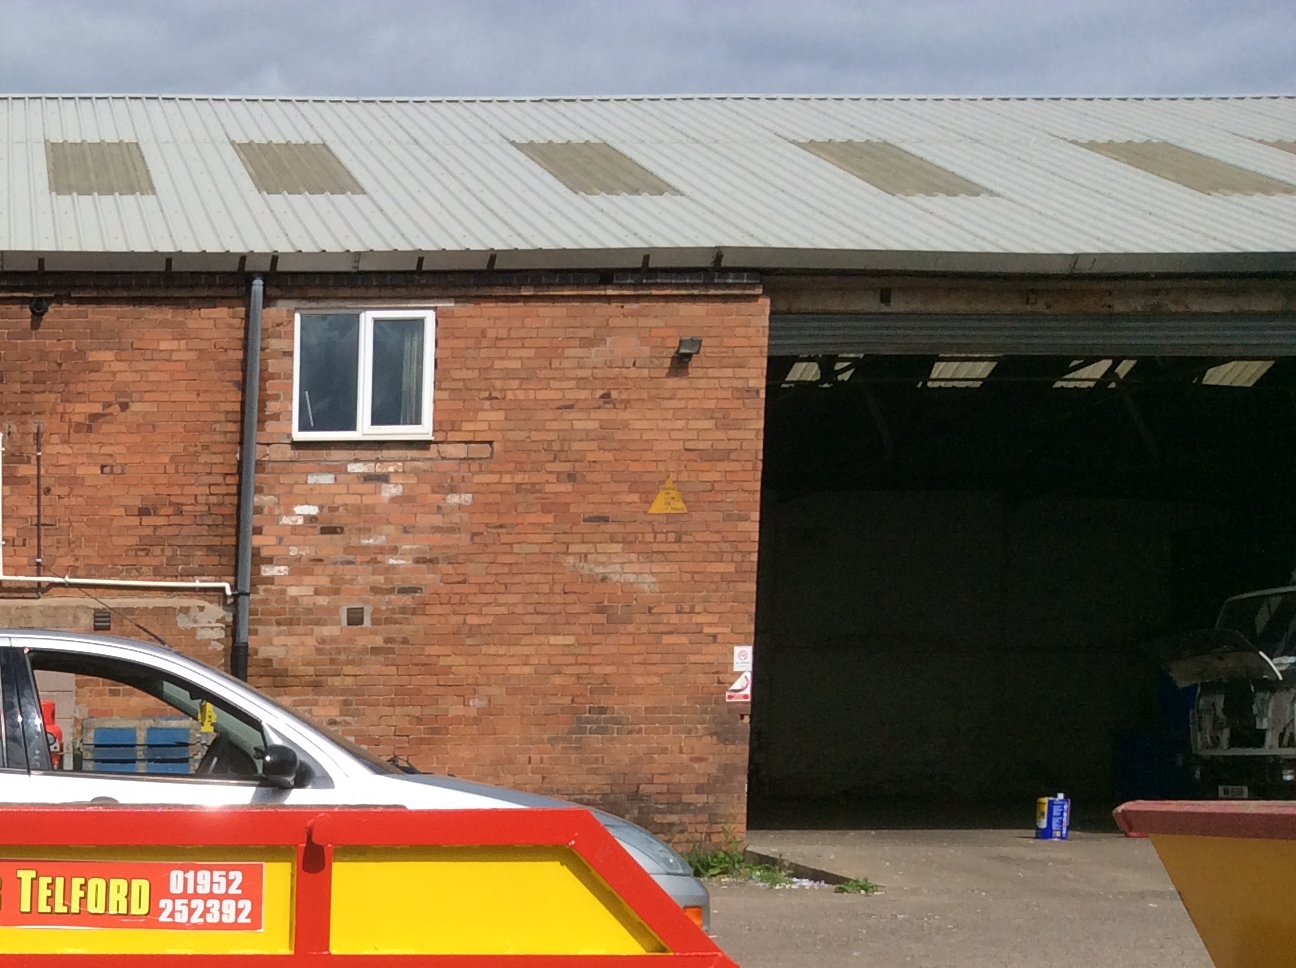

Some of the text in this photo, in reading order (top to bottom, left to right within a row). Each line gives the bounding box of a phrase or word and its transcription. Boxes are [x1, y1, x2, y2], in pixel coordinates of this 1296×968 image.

[16, 869, 151, 917] TELFORD
[169, 869, 243, 895] 01952
[158, 898, 252, 924] 252392
